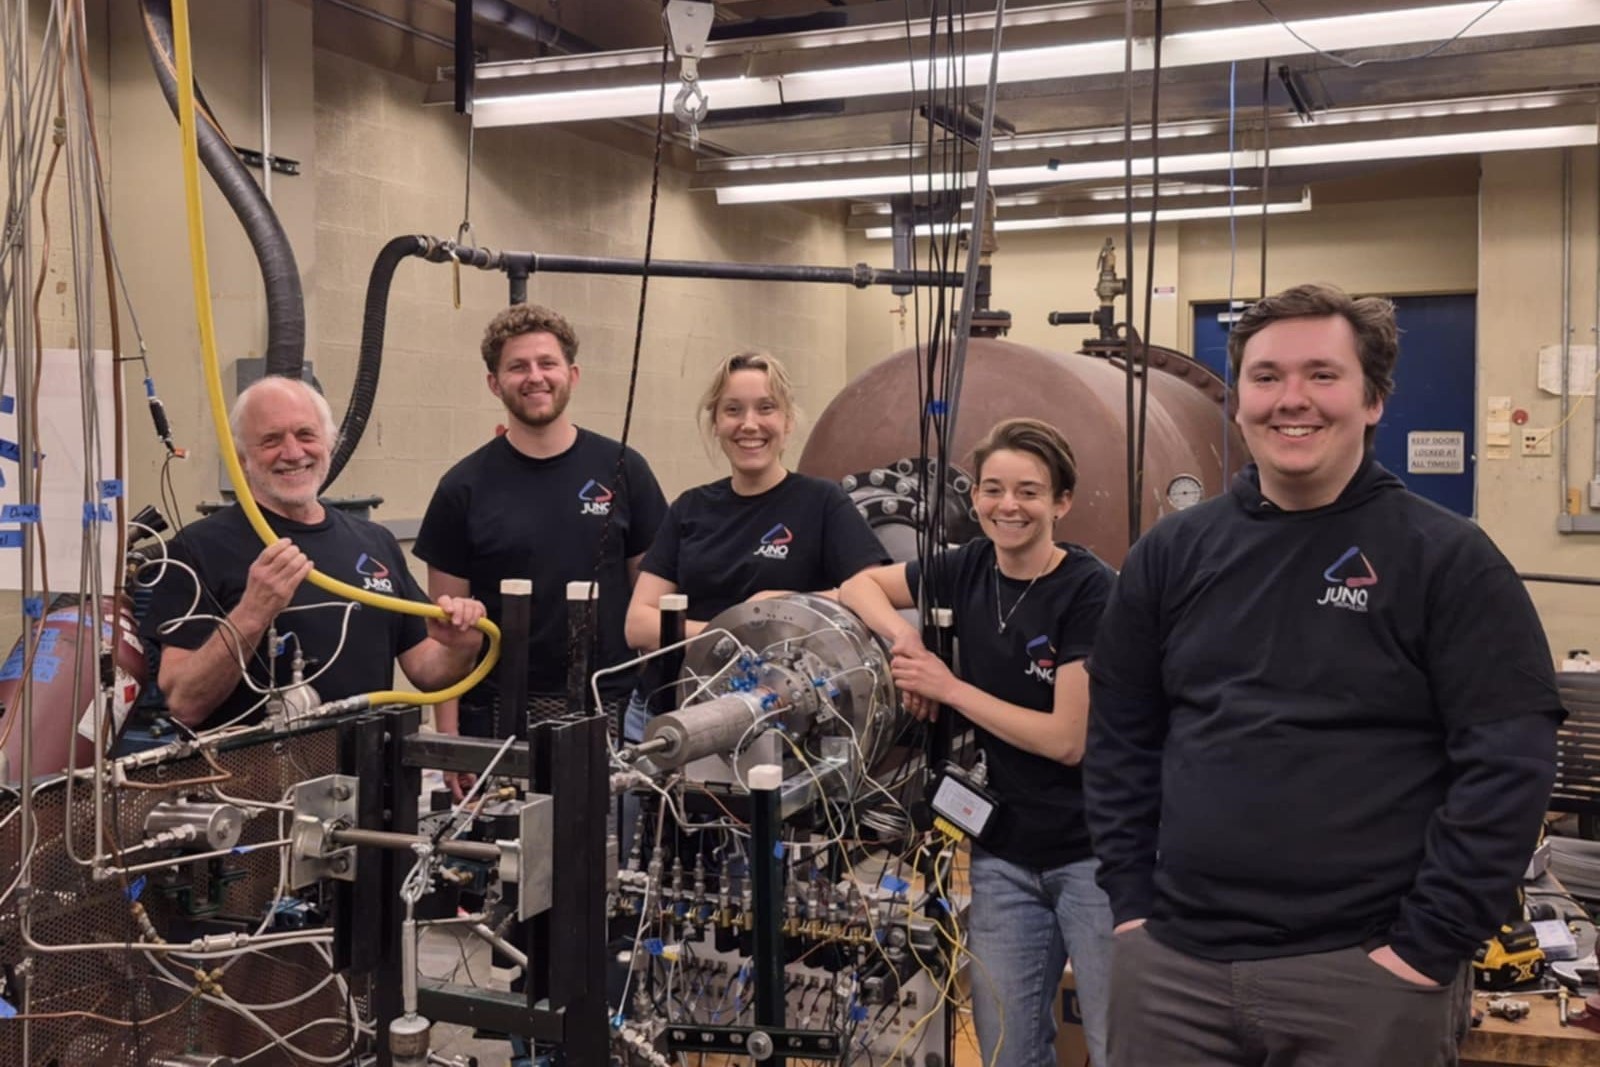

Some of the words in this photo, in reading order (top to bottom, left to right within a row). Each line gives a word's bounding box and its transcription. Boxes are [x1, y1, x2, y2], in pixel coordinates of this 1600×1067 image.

[1446, 449, 1457, 458] AT
[753, 545, 789, 558] JUNO
[362, 577, 392, 591] JUNO
[1316, 586, 1368, 606] JUNO
